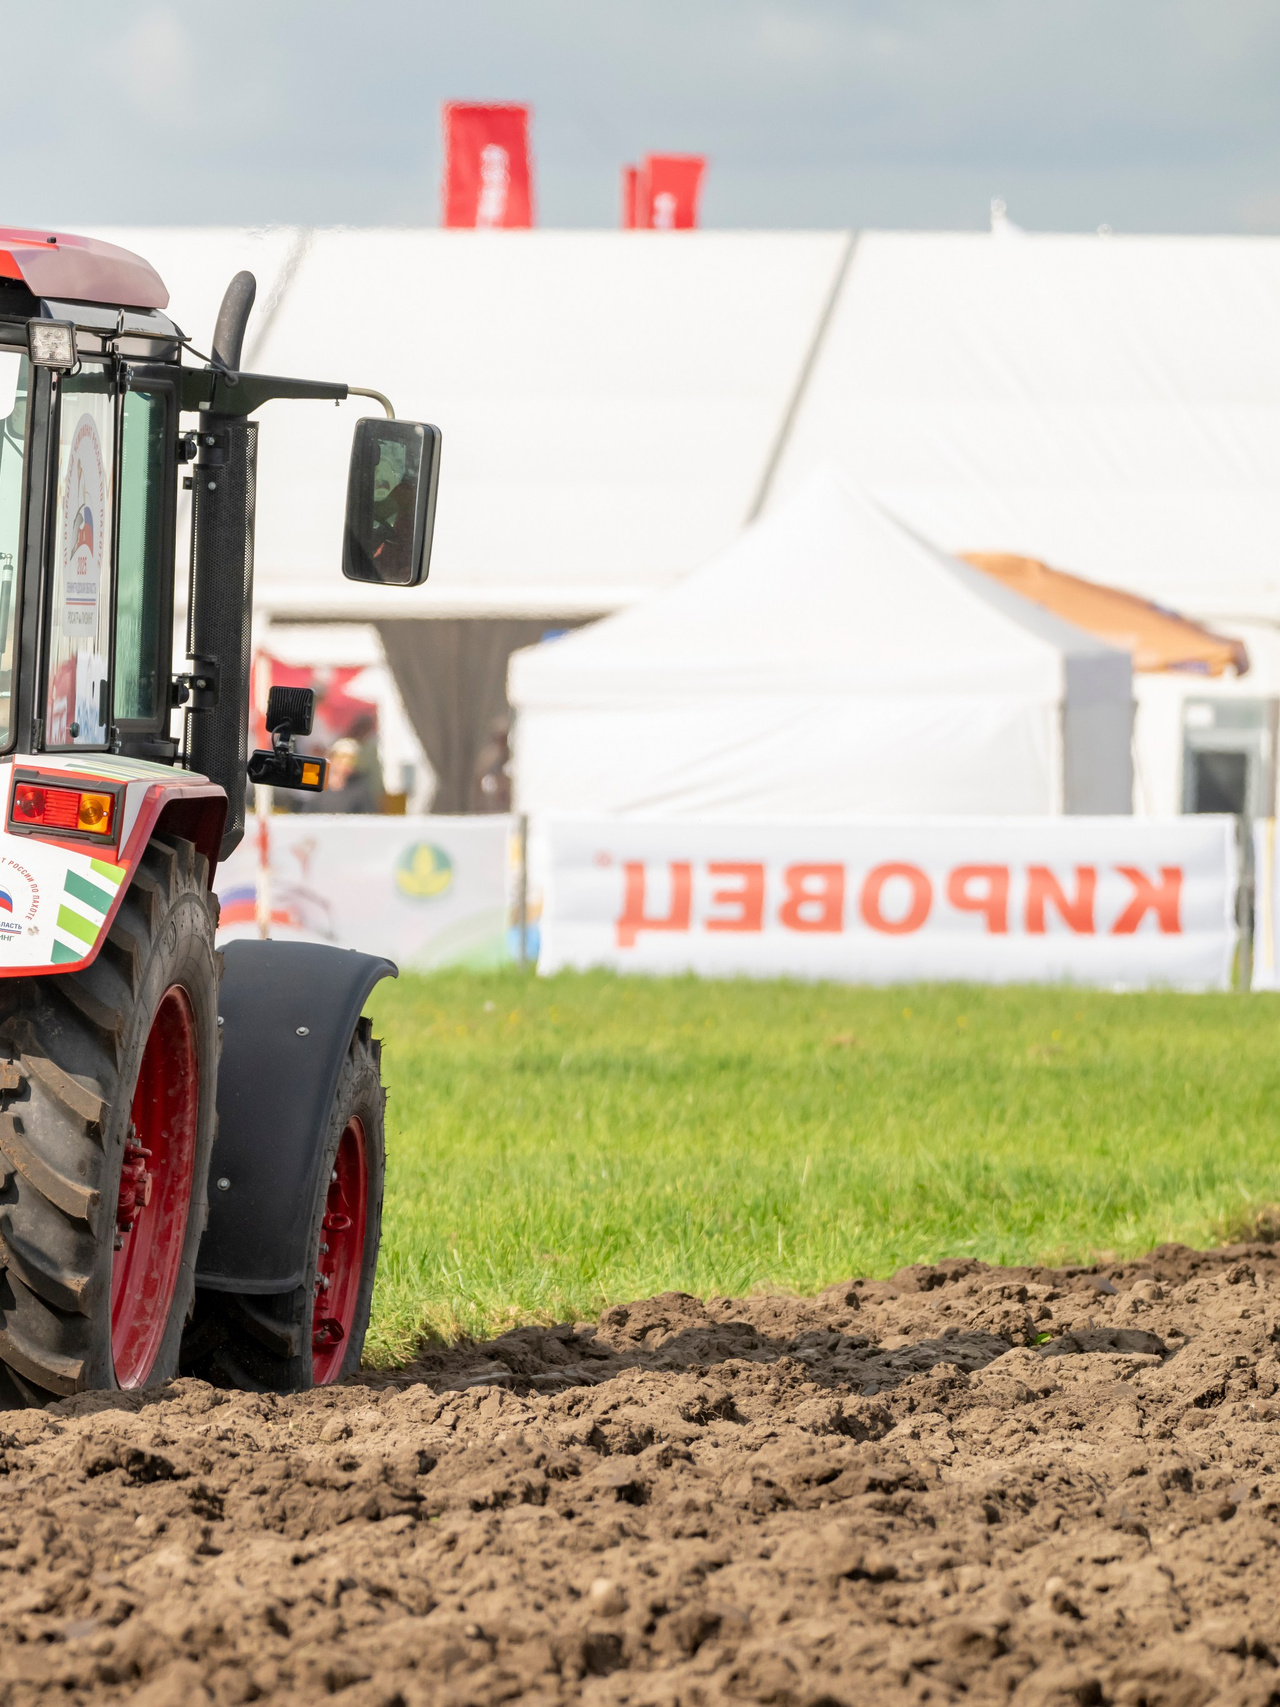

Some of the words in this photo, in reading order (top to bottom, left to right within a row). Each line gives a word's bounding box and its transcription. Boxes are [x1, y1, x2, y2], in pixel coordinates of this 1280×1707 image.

[8, 860, 35, 883] РОССИИ
[30, 884, 39, 893] ПО
[25, 895, 40, 921] ПАХОТЕ
